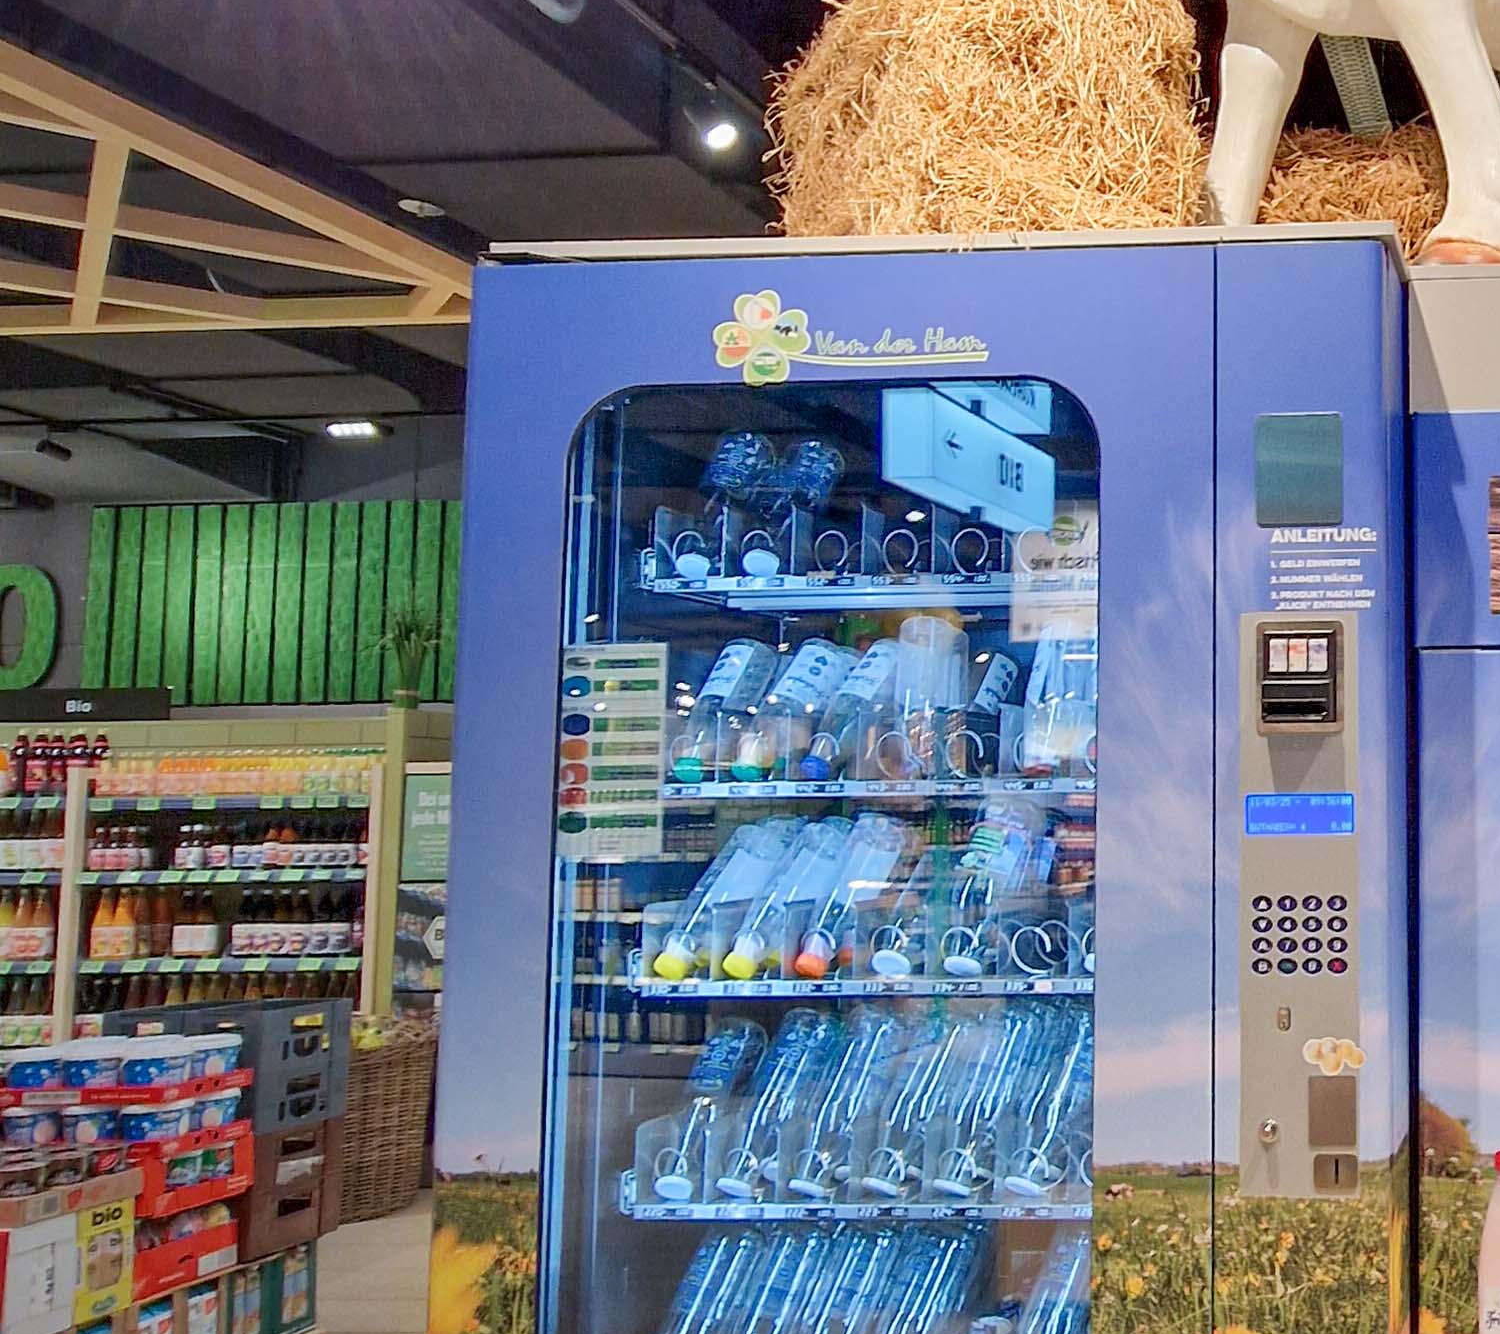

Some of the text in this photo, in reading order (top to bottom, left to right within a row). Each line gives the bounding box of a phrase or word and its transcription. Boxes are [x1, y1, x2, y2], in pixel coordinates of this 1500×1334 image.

[815, 327, 987, 355] Van der Ham
[1270, 528, 1377, 543] ANLEITUNG:
[65, 700, 92, 713] Bio
[92, 1207, 122, 1226] bio
